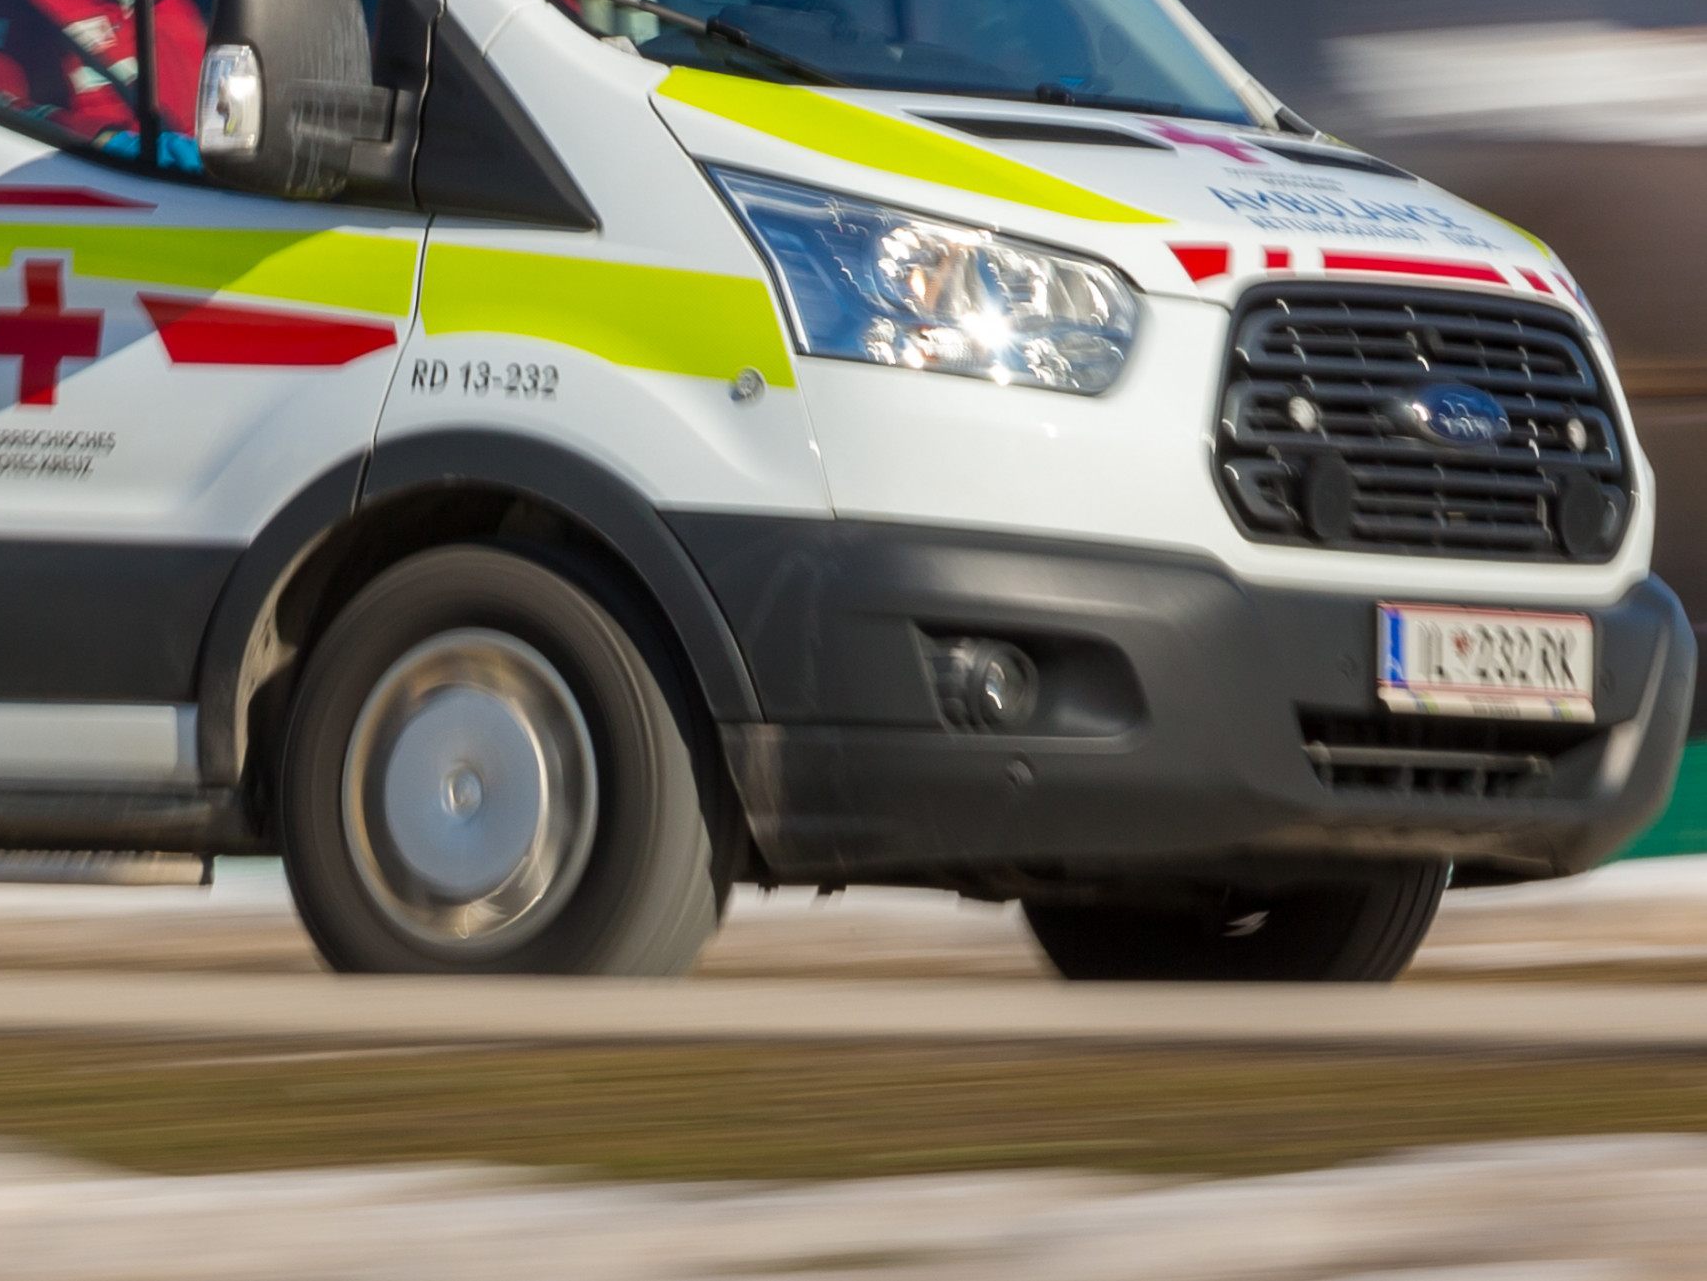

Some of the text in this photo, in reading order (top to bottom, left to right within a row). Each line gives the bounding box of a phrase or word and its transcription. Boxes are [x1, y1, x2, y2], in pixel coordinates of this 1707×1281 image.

[1206, 185, 1471, 231] AMBULANCE
[411, 358, 560, 402] RD 13-232
